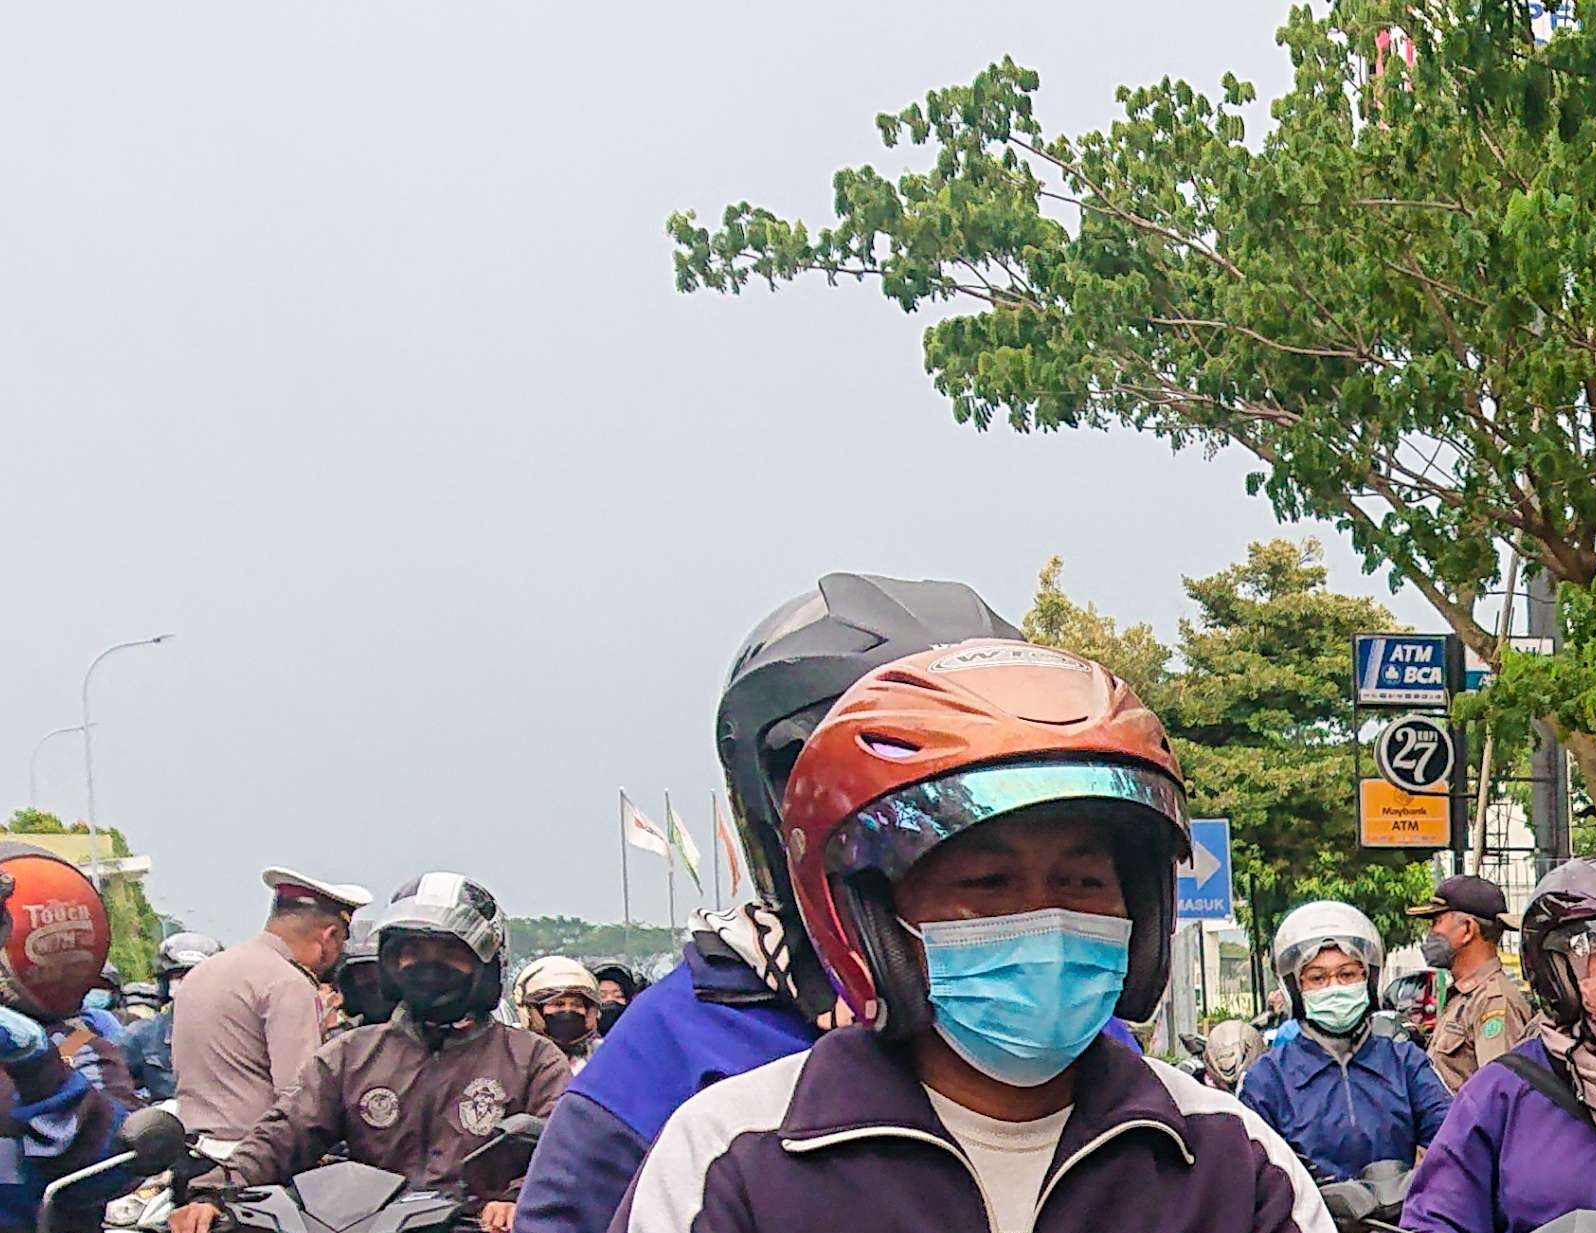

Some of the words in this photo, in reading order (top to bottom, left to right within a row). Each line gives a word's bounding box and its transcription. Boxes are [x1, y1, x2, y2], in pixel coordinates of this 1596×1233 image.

[1390, 644, 1434, 662] ATM
[1403, 666, 1442, 684] BCA
[1416, 730, 1439, 742] KOPI
[1393, 727, 1439, 784] 27
[1382, 806, 1428, 818] Maybank
[1391, 821, 1419, 832] ATM
